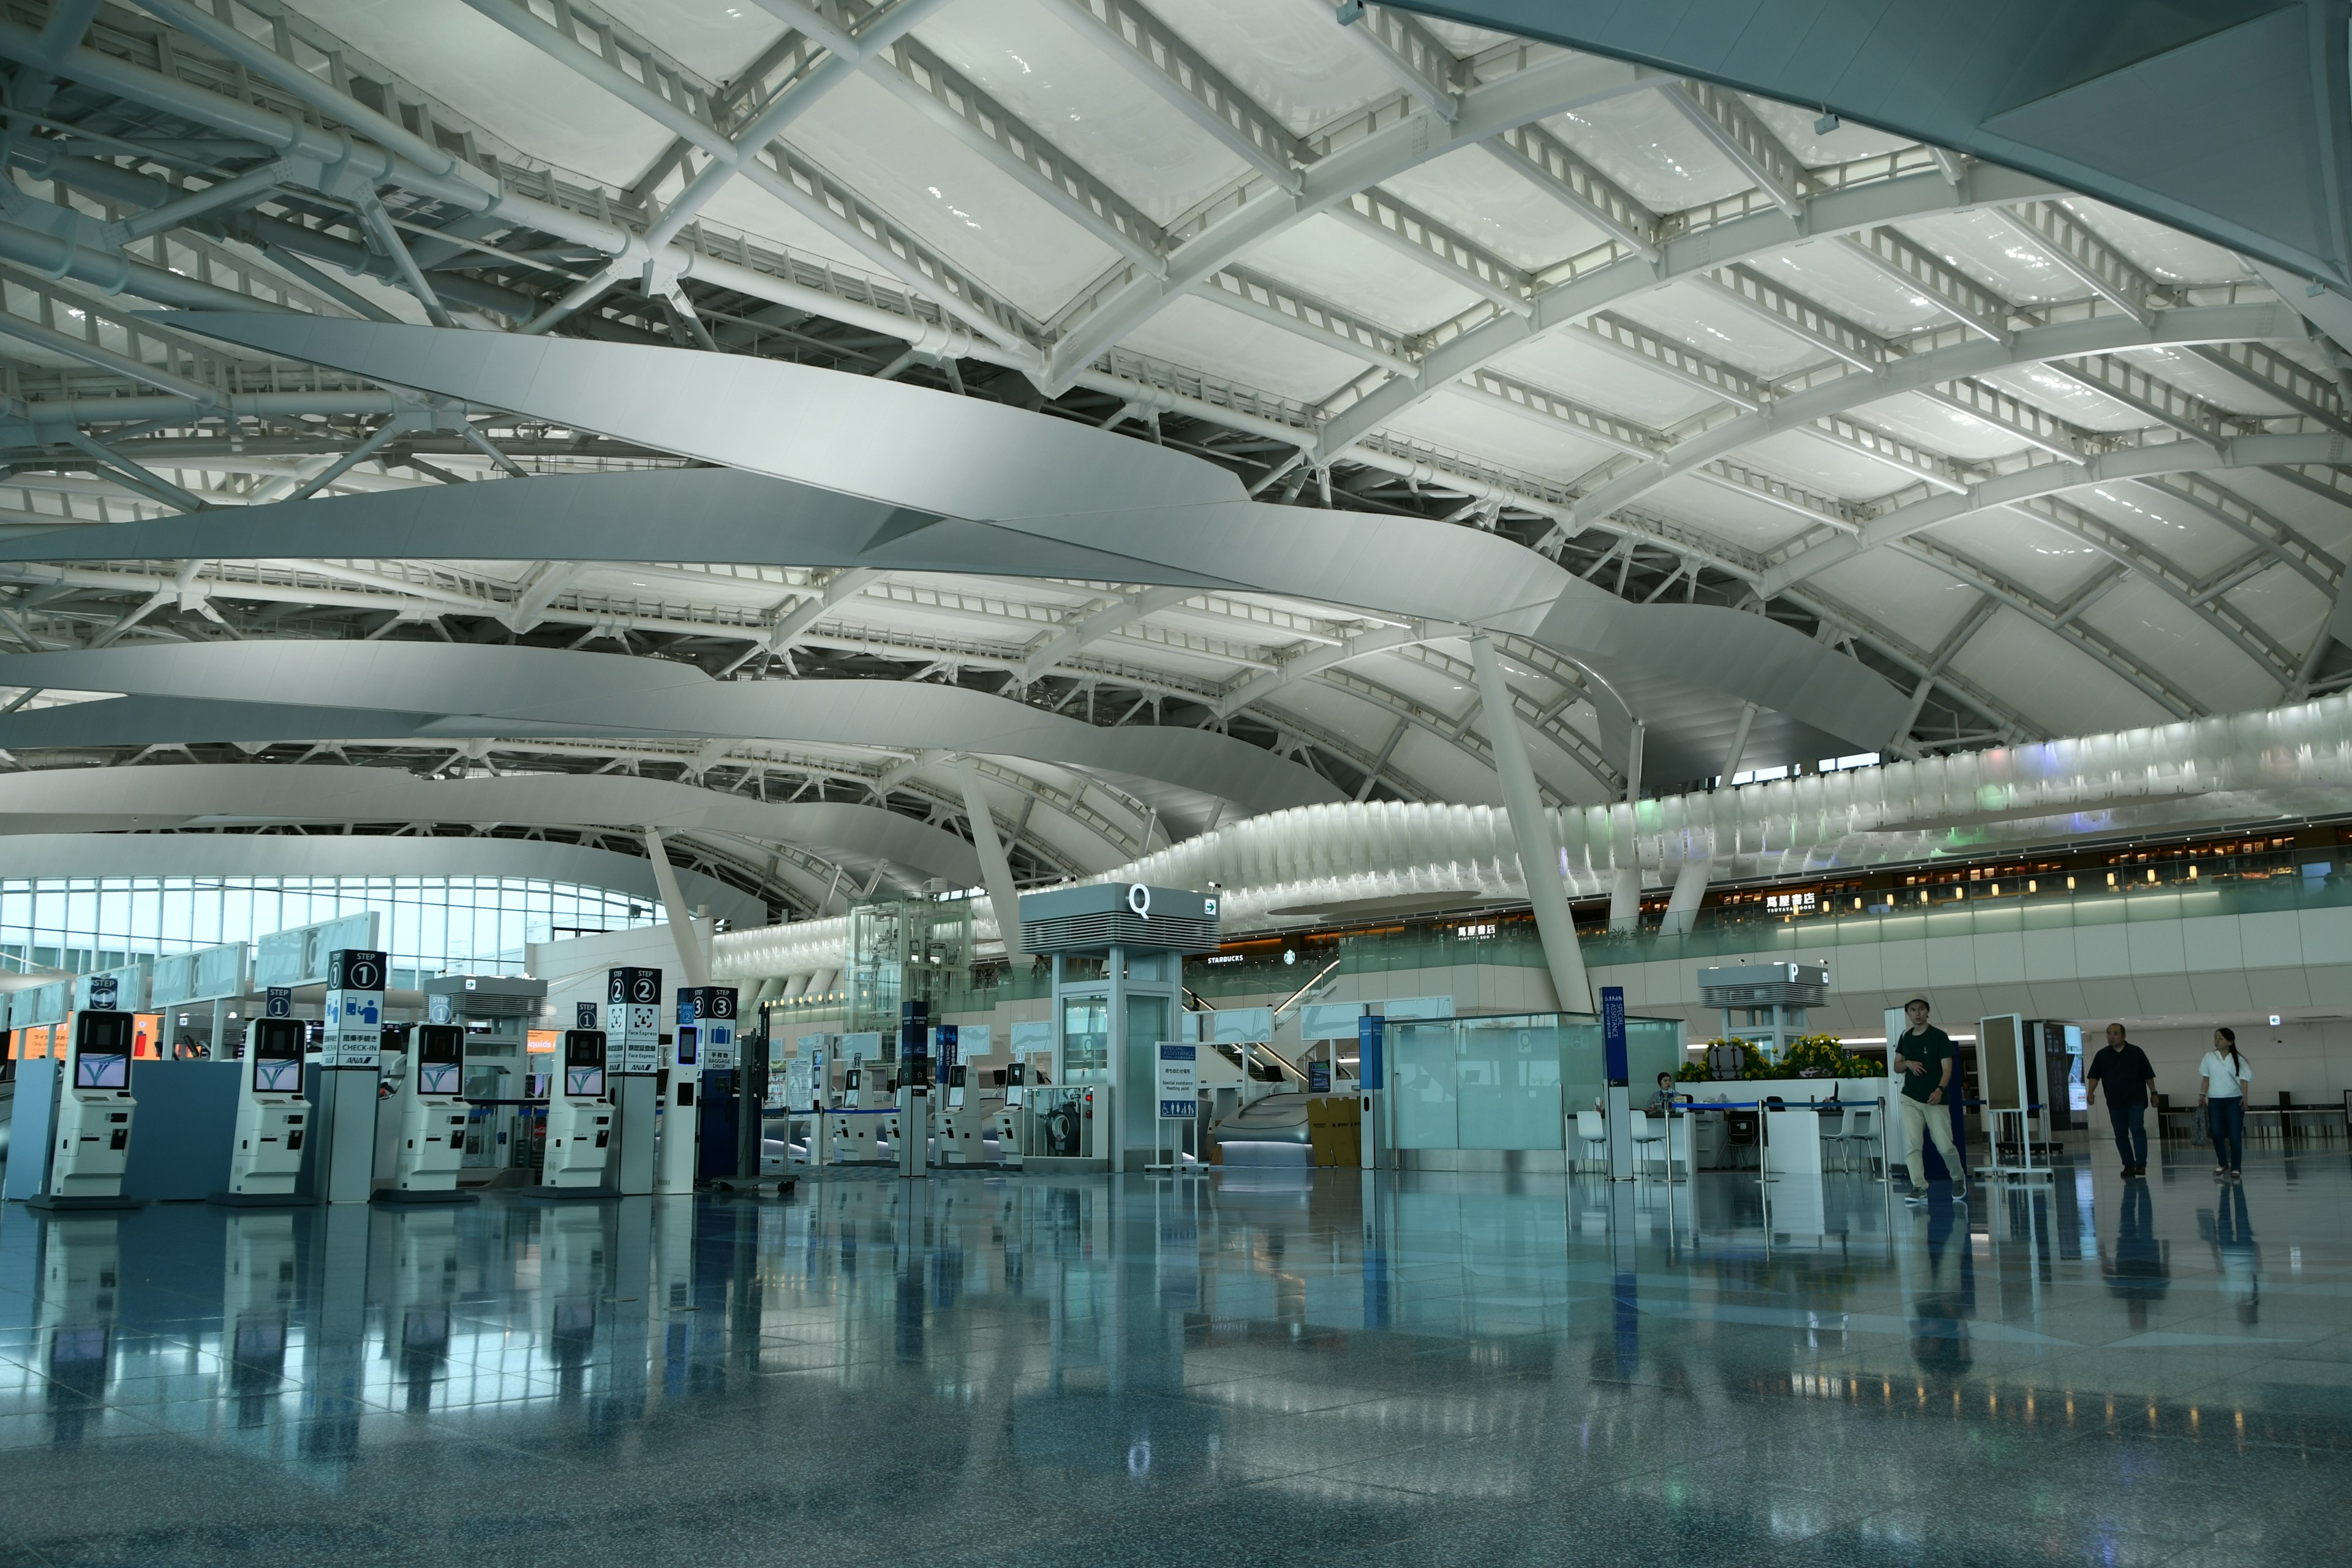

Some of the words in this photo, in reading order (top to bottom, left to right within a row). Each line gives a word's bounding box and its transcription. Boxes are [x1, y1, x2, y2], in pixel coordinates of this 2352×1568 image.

[1129, 883, 1150, 919] Q
[1207, 955, 1243, 964] STARBUCKS
[1789, 963, 1798, 982] P
[528, 1040, 551, 1049] iquids
